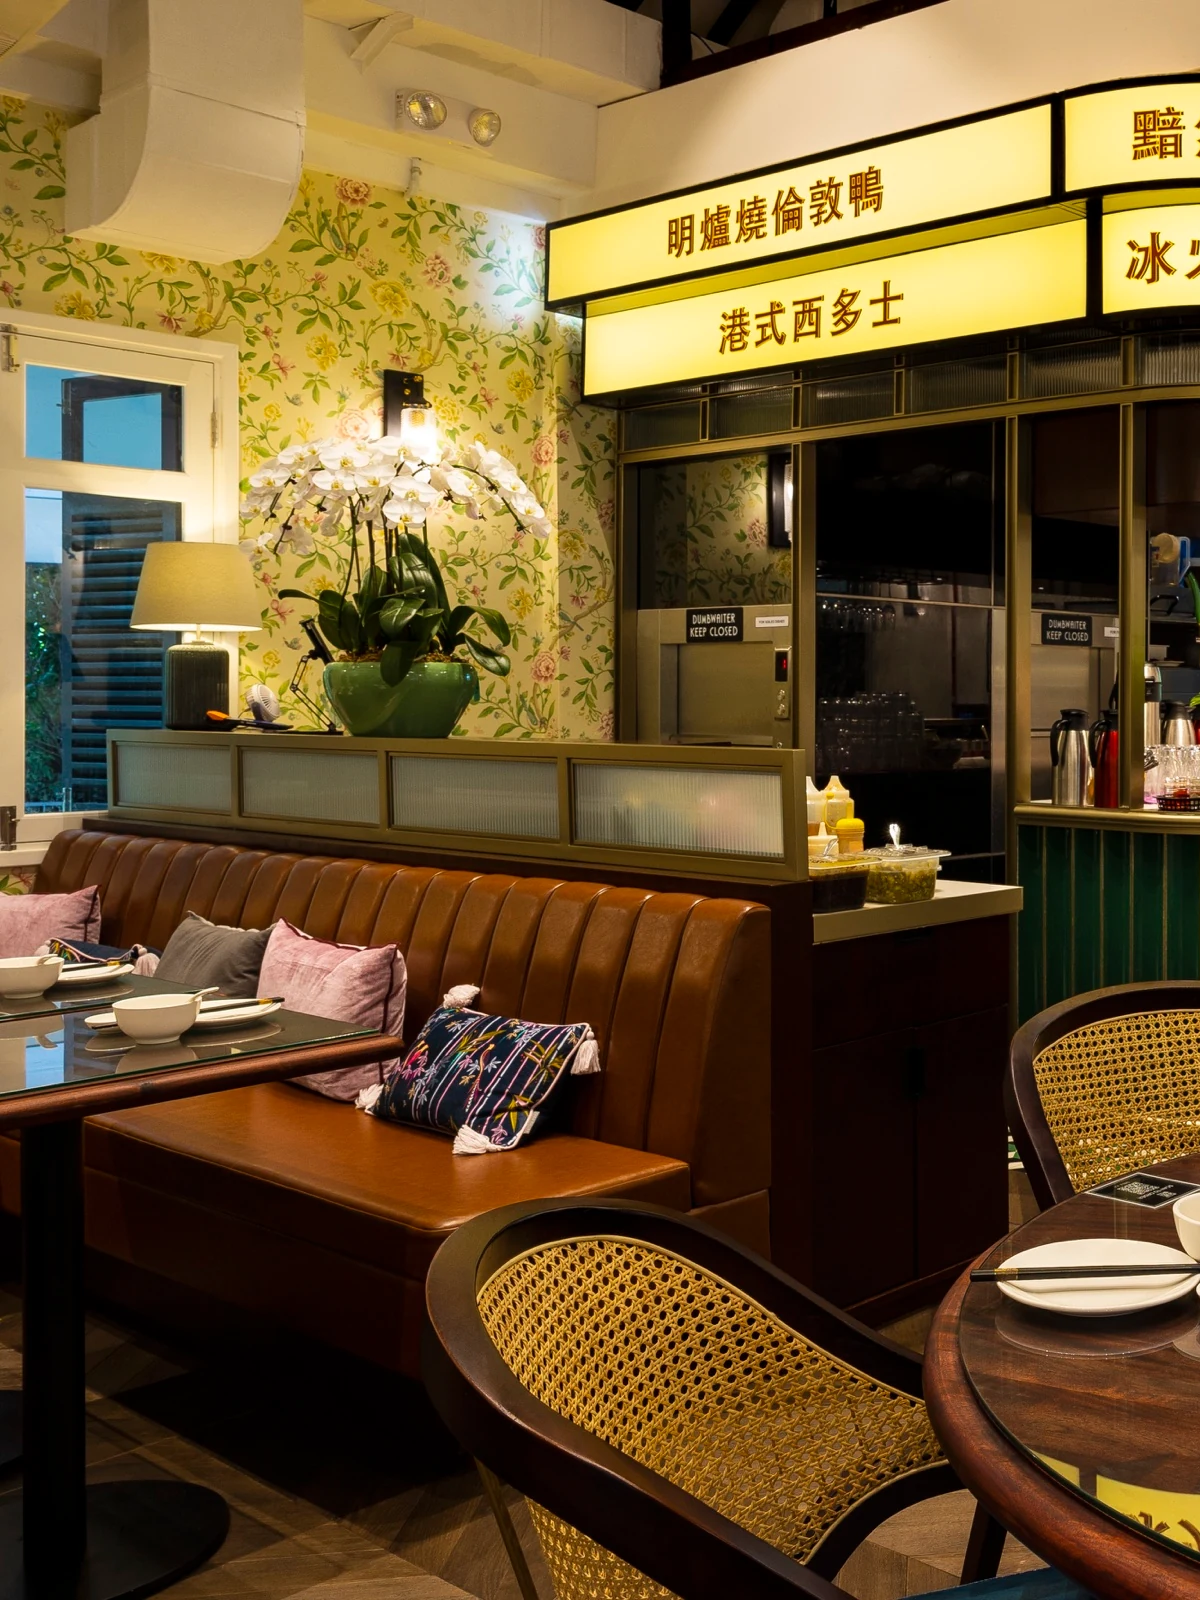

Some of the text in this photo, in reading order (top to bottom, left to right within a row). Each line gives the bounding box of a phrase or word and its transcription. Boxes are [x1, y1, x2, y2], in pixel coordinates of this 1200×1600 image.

[667, 165, 885, 258] 明爐燒倫敦鴨
[718, 280, 904, 355] 港式西多士
[692, 613, 736, 624] DUMBWAITER
[1048, 619, 1087, 630] DUMBWAITER
[690, 626, 738, 637] KEEP CLOSED
[1046, 631, 1089, 641] KEEP CLOSED
